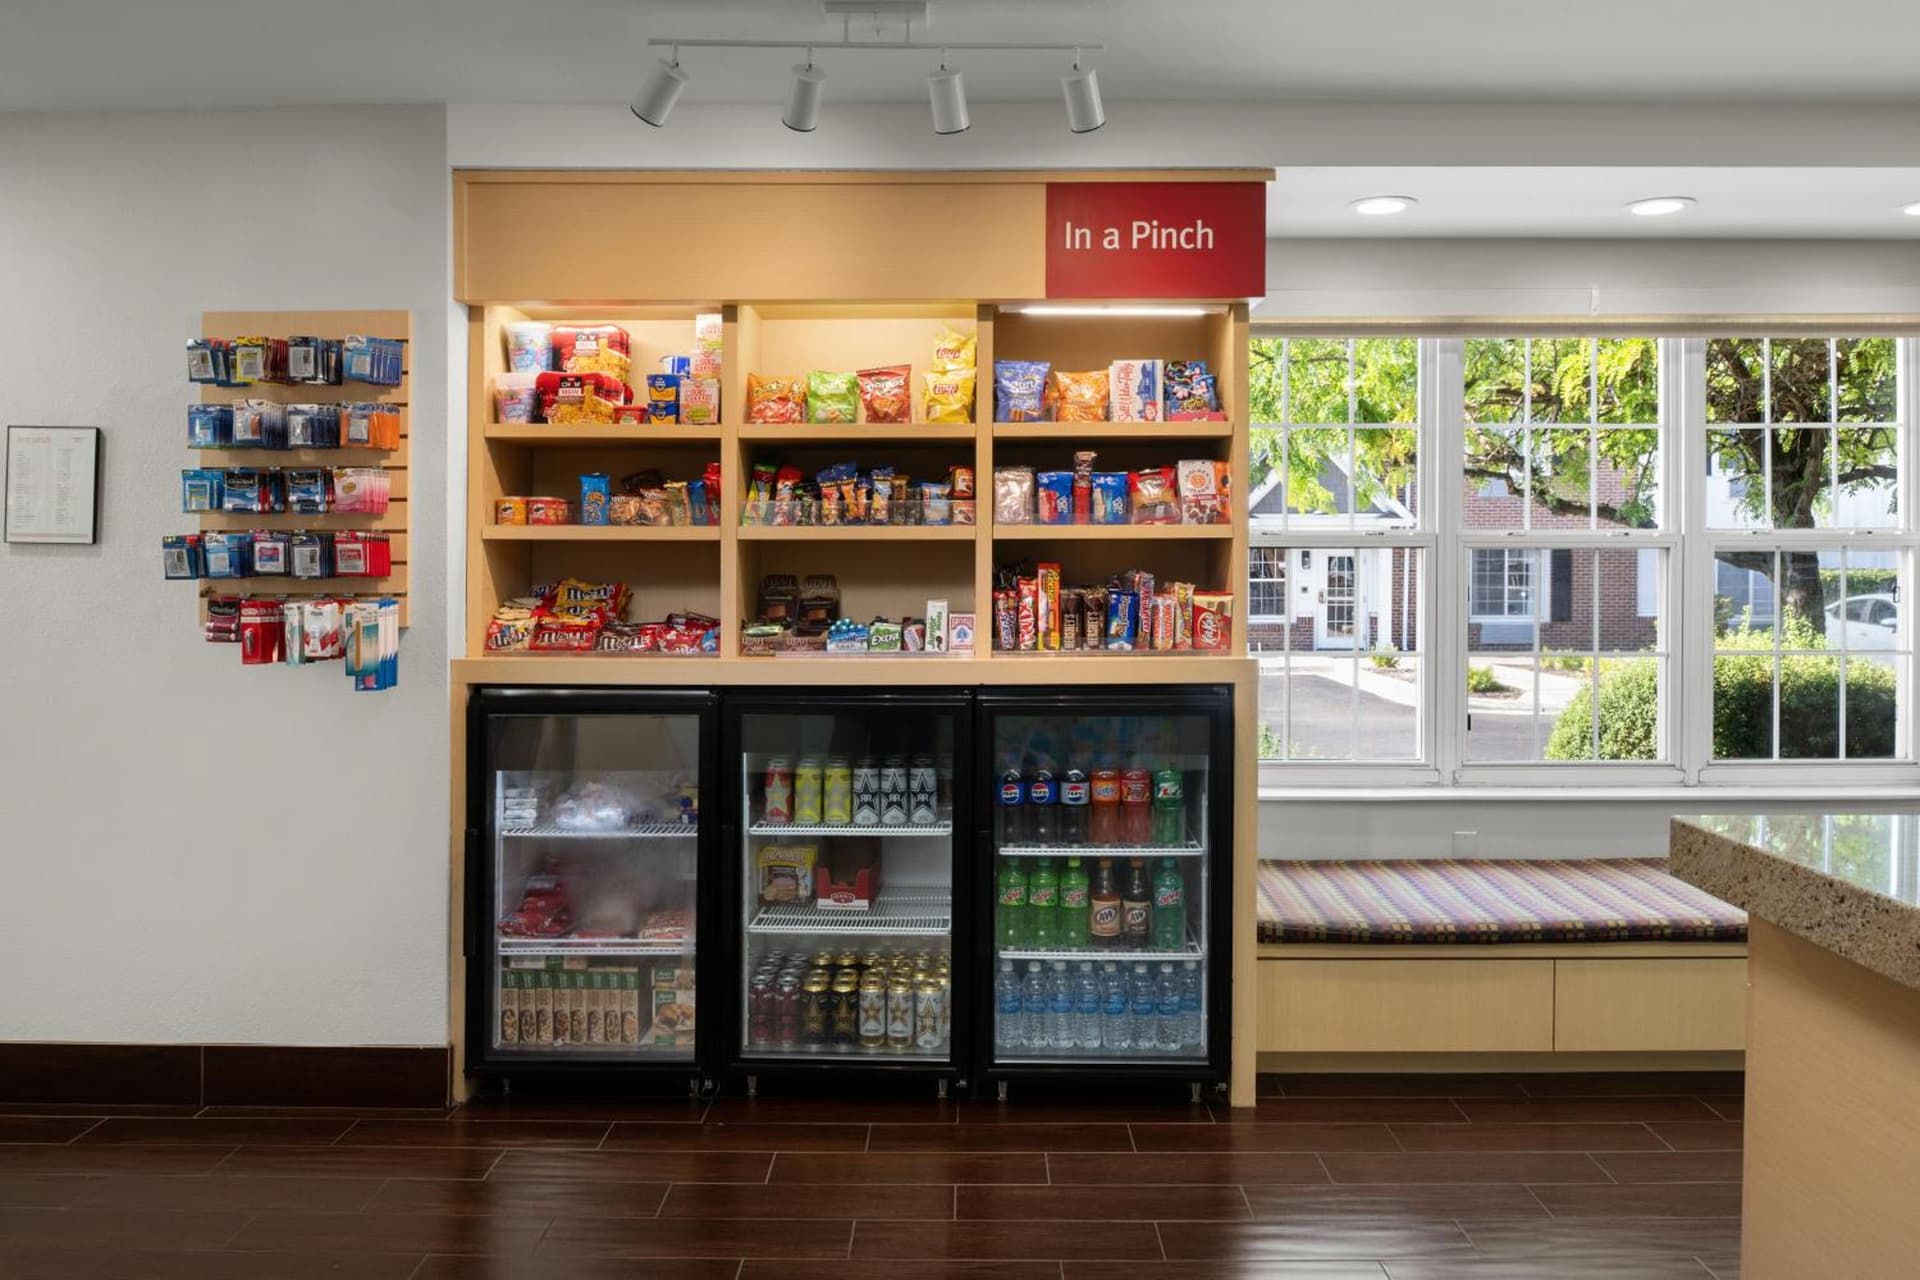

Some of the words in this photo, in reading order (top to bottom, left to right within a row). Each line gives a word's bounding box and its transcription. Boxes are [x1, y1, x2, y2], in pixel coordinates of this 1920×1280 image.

[1065, 221, 1091, 249] In
[1102, 227, 1120, 249] a
[1132, 219, 1213, 249] Pinch
[871, 632, 900, 645] Extra
[927, 616, 937, 648] Junior
